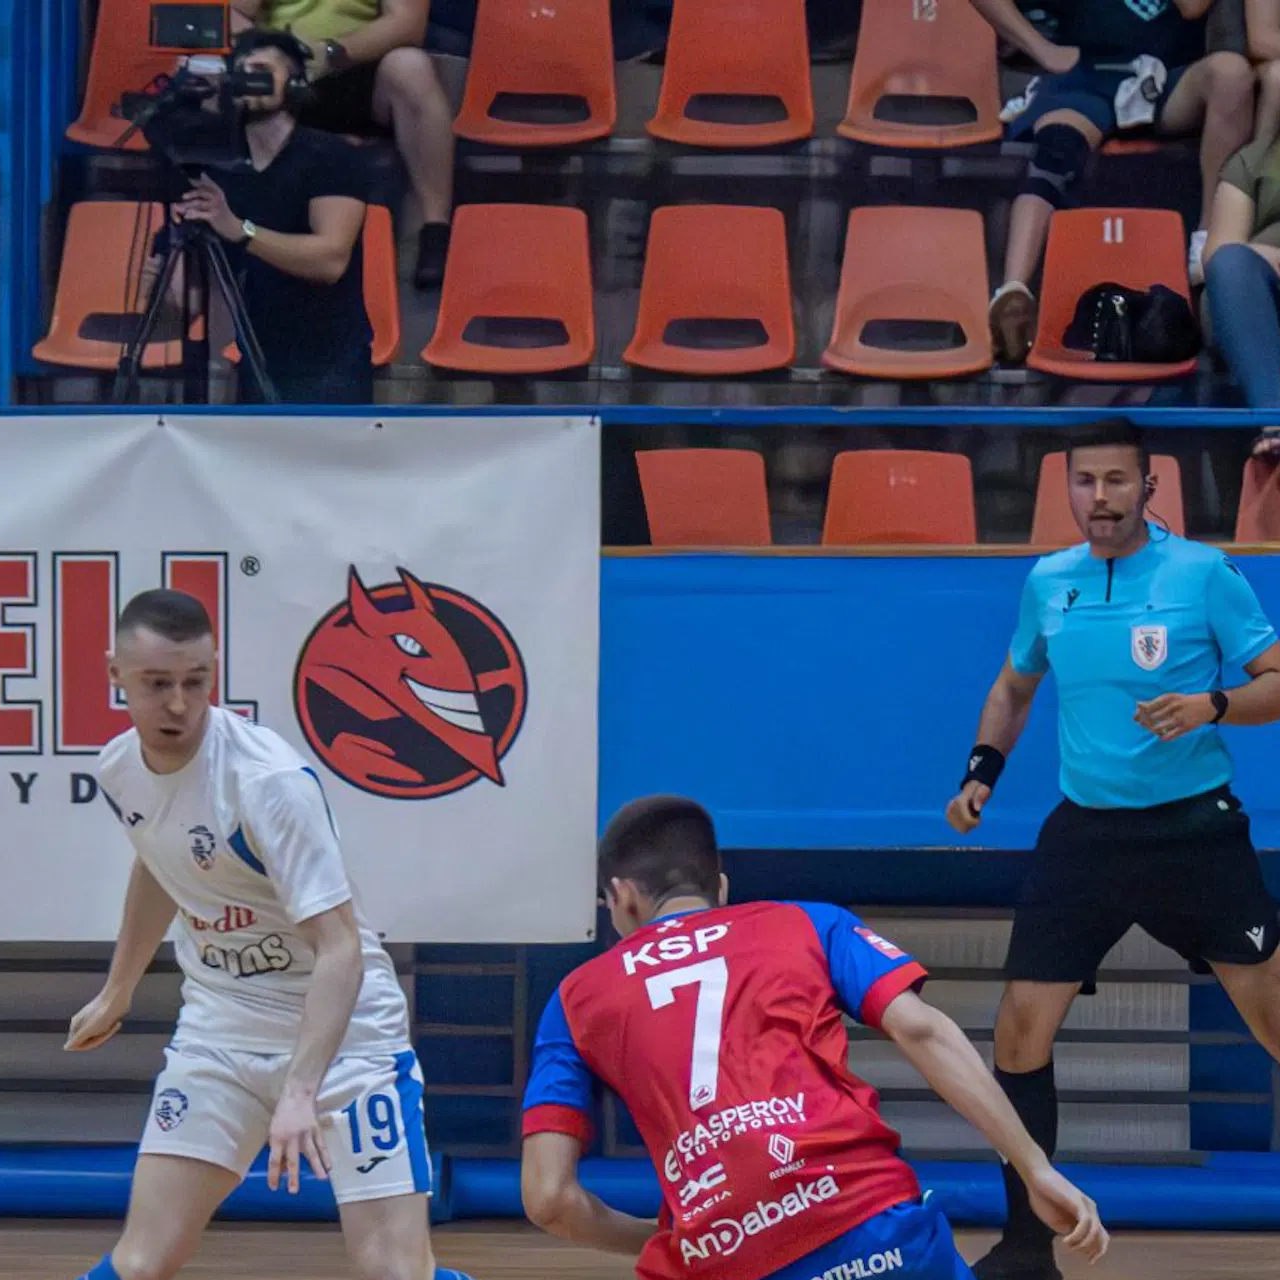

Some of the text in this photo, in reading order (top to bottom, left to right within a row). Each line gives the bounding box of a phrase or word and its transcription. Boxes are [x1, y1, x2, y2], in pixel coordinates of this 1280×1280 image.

[1103, 216, 1124, 243] 11
[622, 923, 730, 976] KSP
[645, 956, 729, 1112] 7
[341, 1093, 400, 1154] 19
[684, 1112, 807, 1164] AUTOMOBILI
